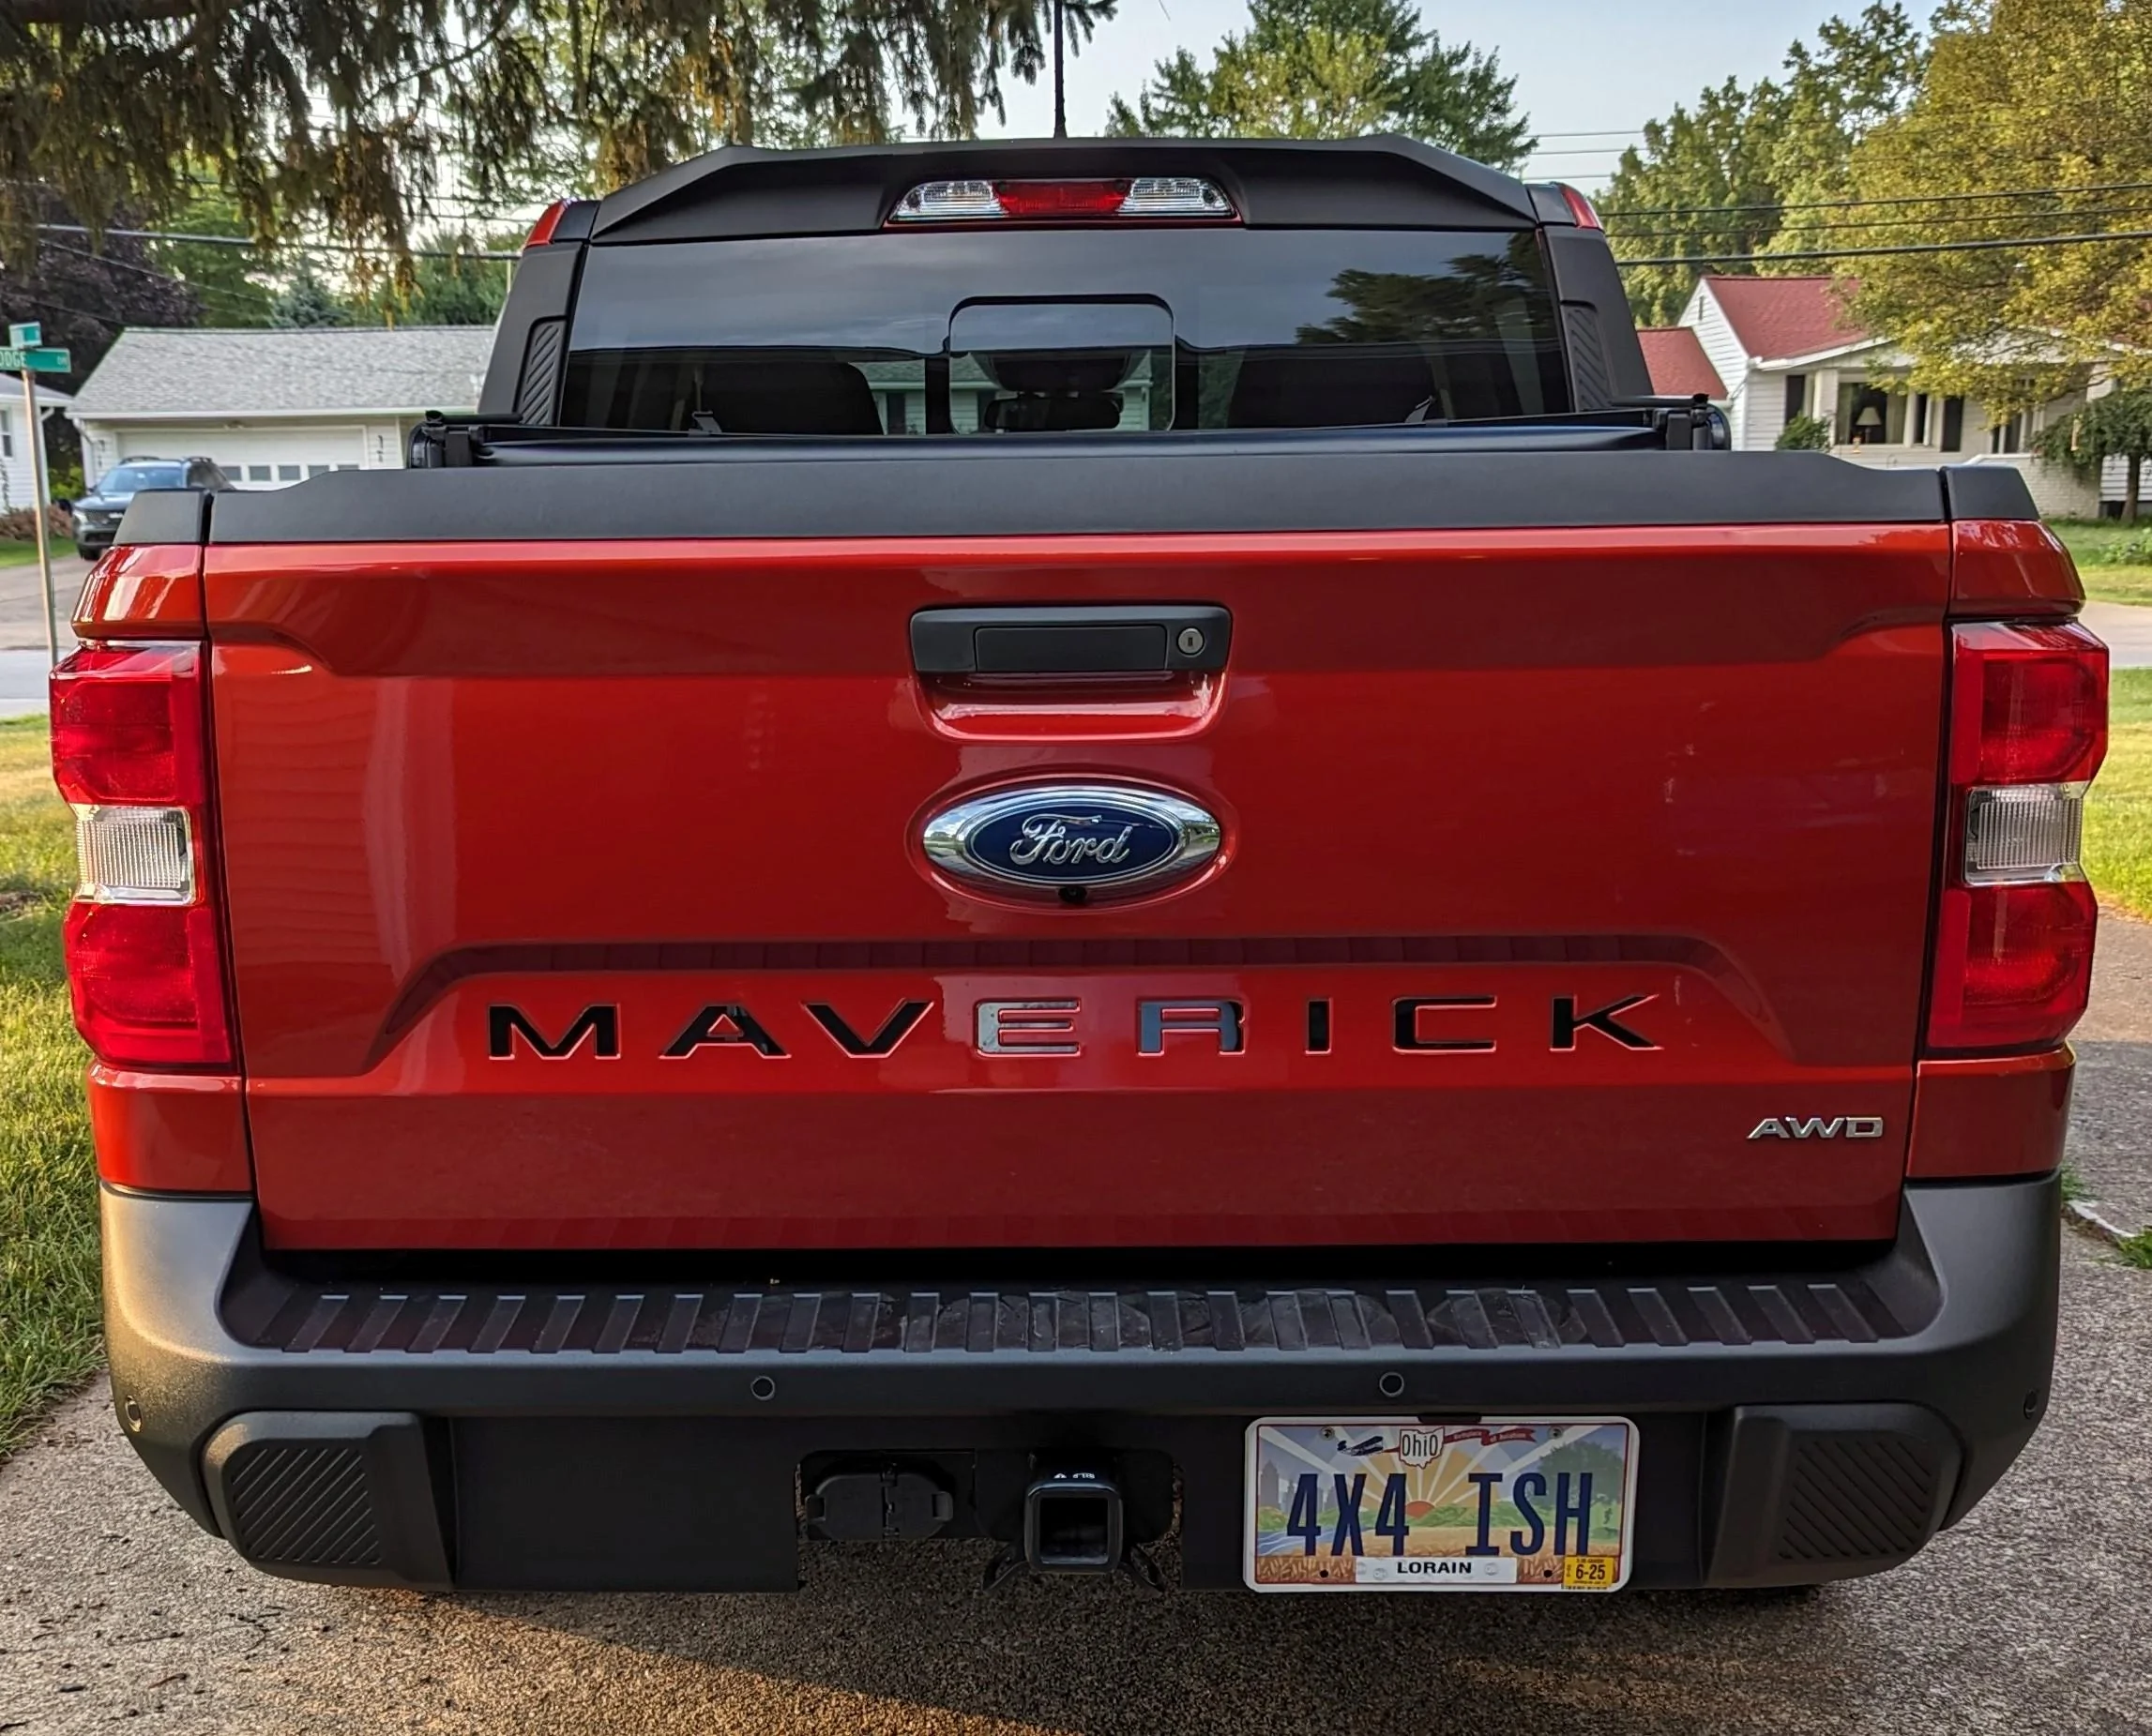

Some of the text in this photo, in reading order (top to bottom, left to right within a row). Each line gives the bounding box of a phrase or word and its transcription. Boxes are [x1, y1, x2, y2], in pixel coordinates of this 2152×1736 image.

[1009, 813, 1133, 865] Ford
[489, 993, 1664, 1060] MAVERICK
[1747, 1116, 1884, 1139] AWD
[1286, 1472, 1593, 1557] 4X4 ISH
[1397, 1561, 1472, 1575] LORAIN
[1576, 1563, 1606, 1580] 6-25
